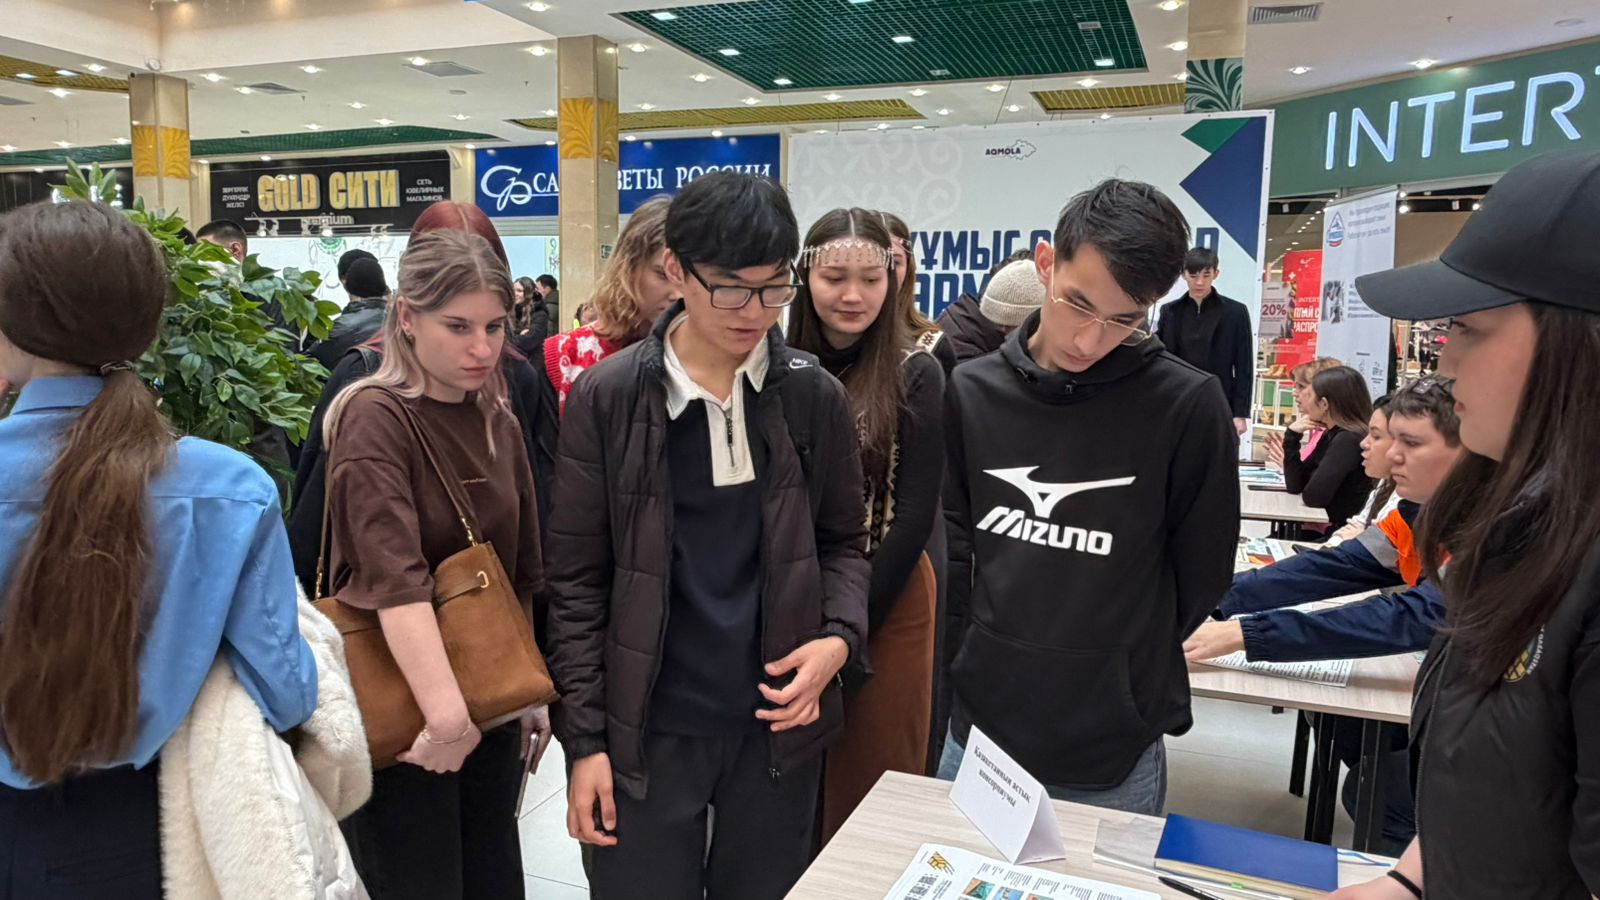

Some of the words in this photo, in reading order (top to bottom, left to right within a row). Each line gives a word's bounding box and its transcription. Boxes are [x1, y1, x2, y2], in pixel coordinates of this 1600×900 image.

[1325, 65, 1600, 170] INTER
[257, 174, 320, 212] GOLD
[329, 169, 400, 210] СИТИ
[416, 178, 432, 186] СЕТЬ
[911, 229, 1021, 270] ҰМЫС
[1262, 303, 1287, 316] 20%
